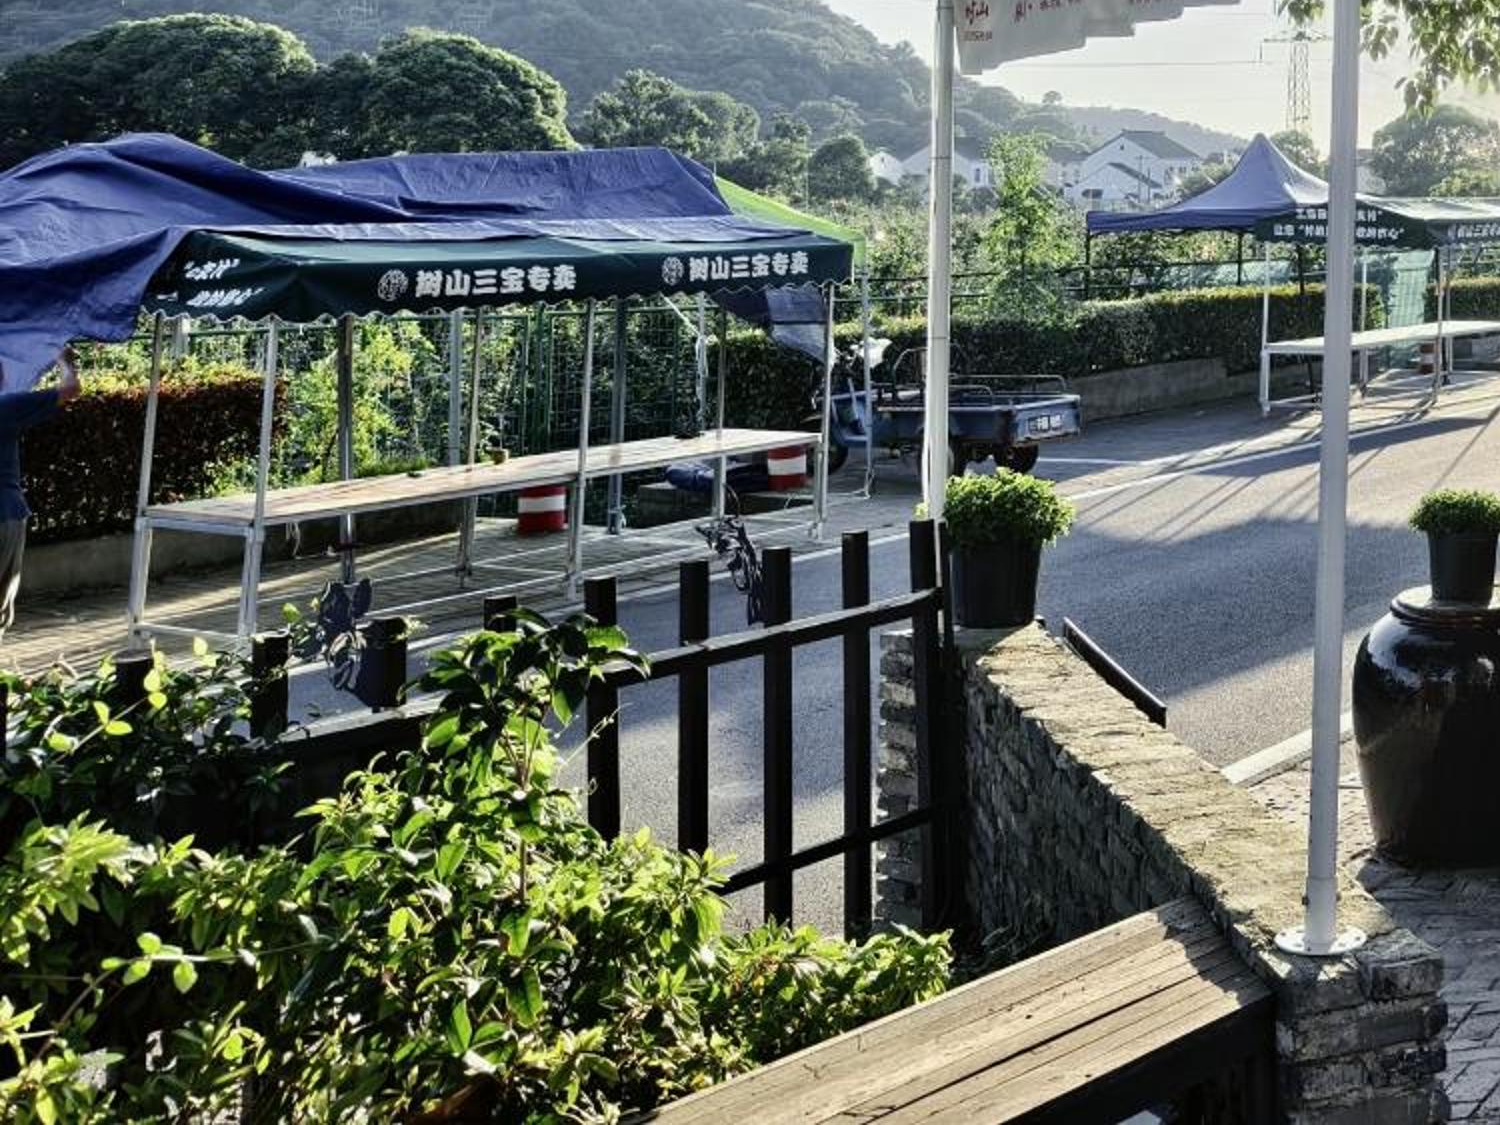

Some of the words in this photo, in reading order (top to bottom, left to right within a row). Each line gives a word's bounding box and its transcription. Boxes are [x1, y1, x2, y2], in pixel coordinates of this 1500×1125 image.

[414, 264, 577, 299] 树山三宝专卖
[688, 250, 809, 282] 树山三宝专卖
